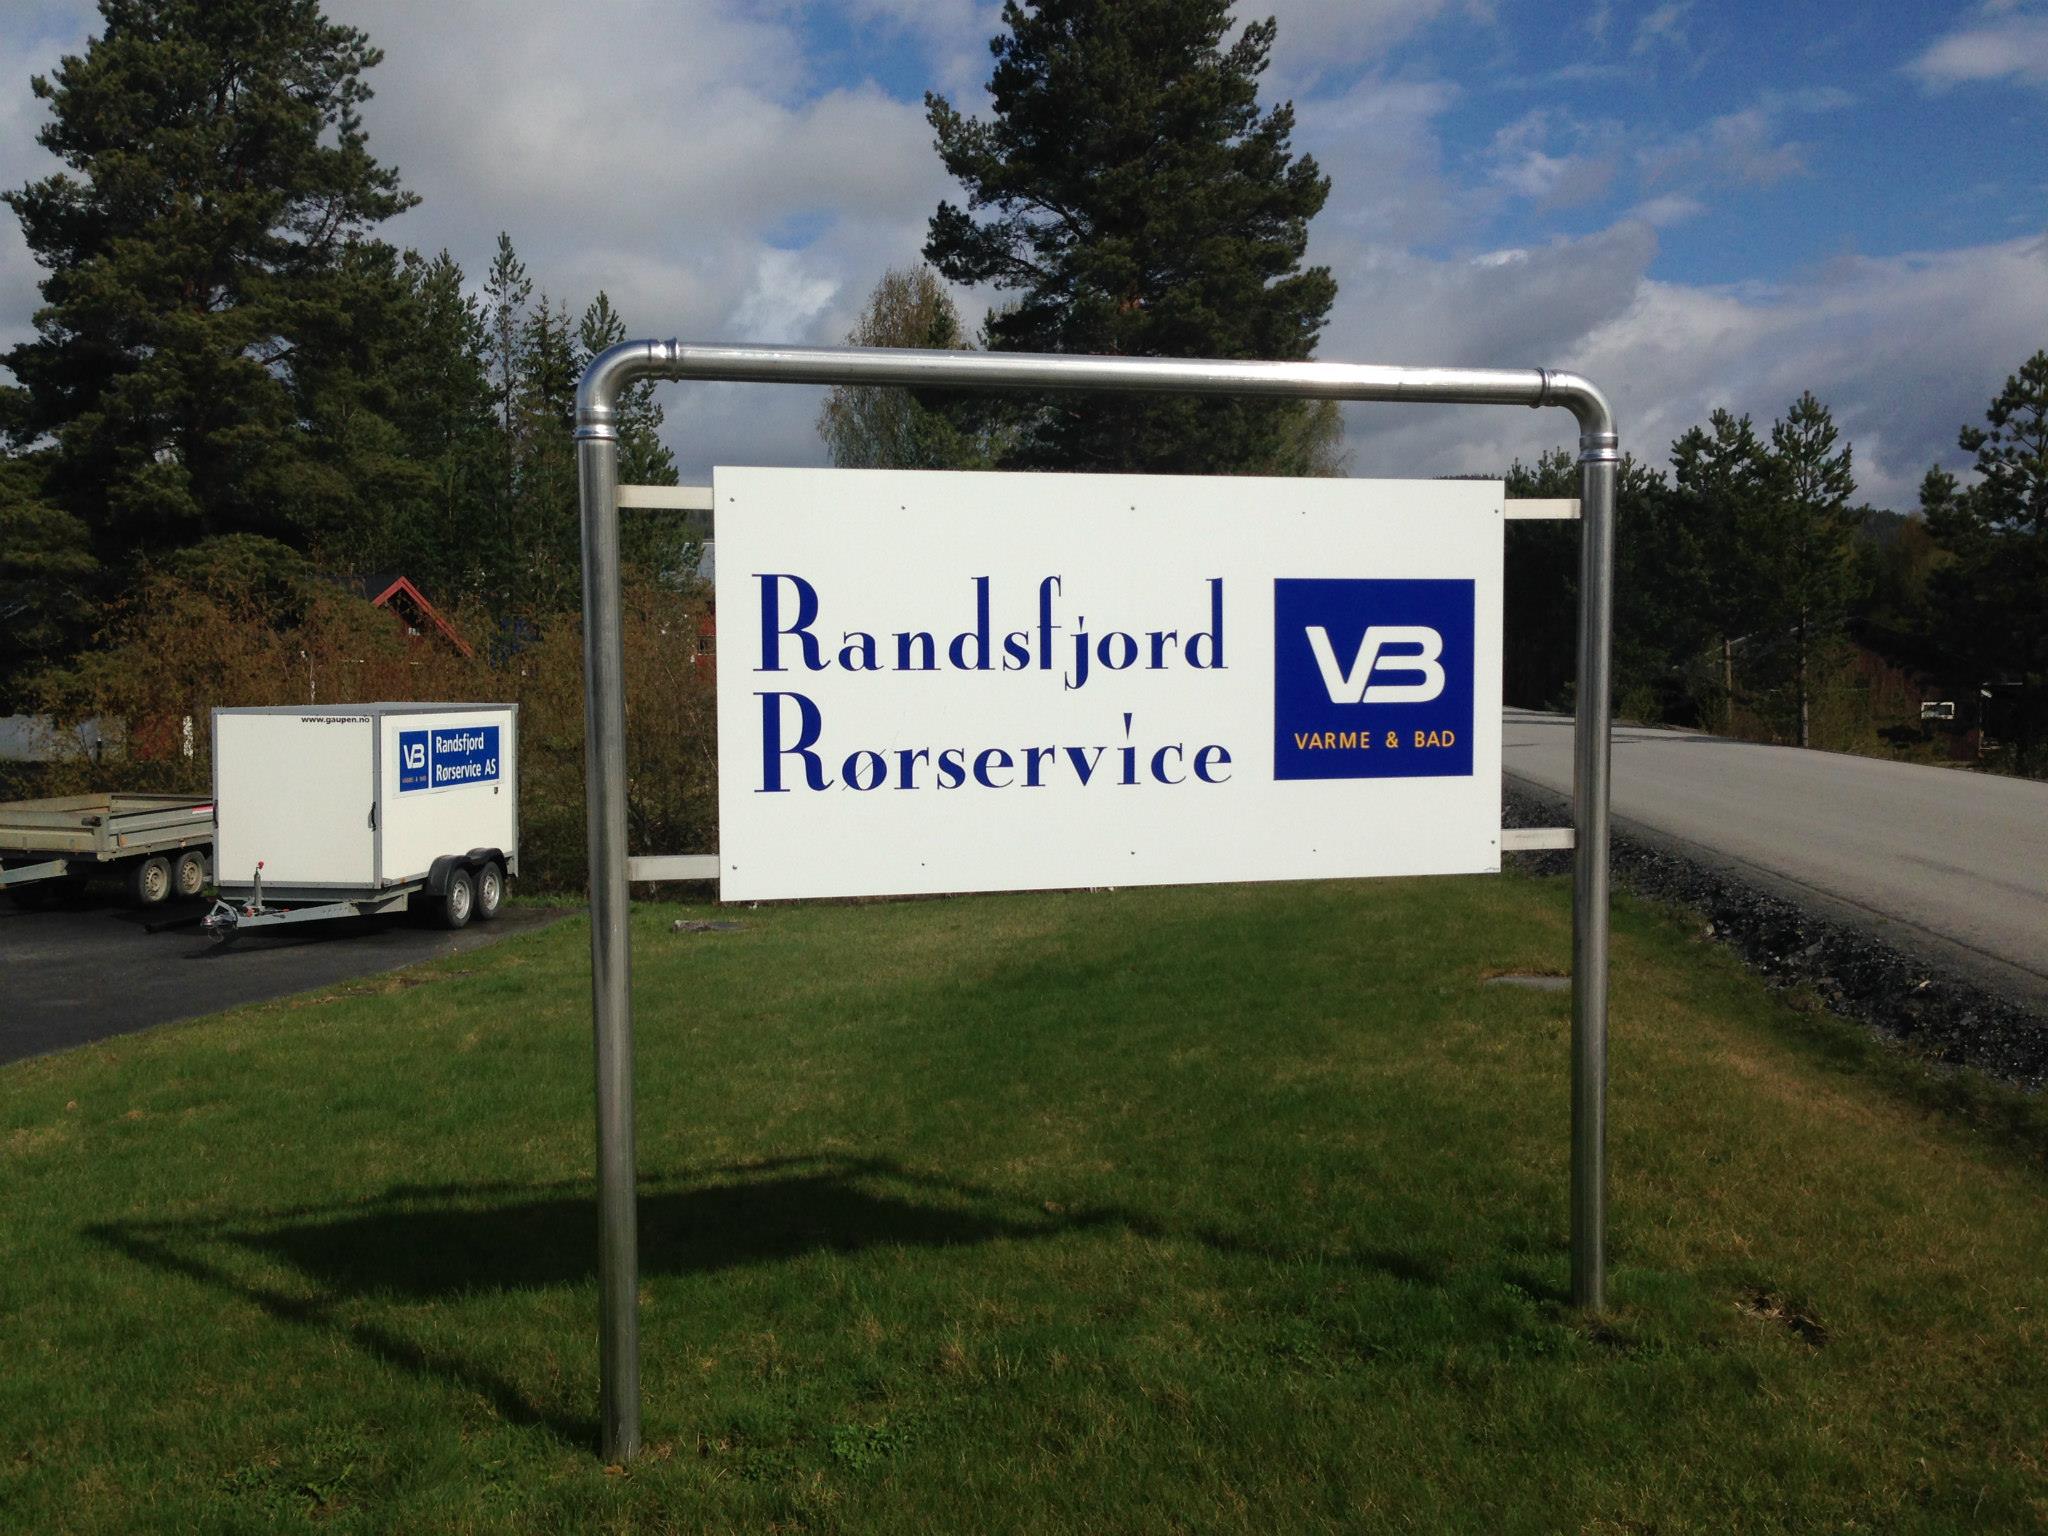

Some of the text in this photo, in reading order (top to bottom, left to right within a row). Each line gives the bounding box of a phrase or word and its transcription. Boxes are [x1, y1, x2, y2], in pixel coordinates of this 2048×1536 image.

[751, 573, 1229, 691] Randsfjord
[1305, 626, 1446, 704] VB
[301, 717, 370, 725] www.gaupen.no
[435, 732, 484, 756] Randsfjord
[753, 691, 1232, 793] Rørservice
[1294, 730, 1455, 750] VARME & BAD
[403, 743, 426, 770] VB
[436, 760, 482, 782] Rørservice
[484, 758, 497, 776] AS
